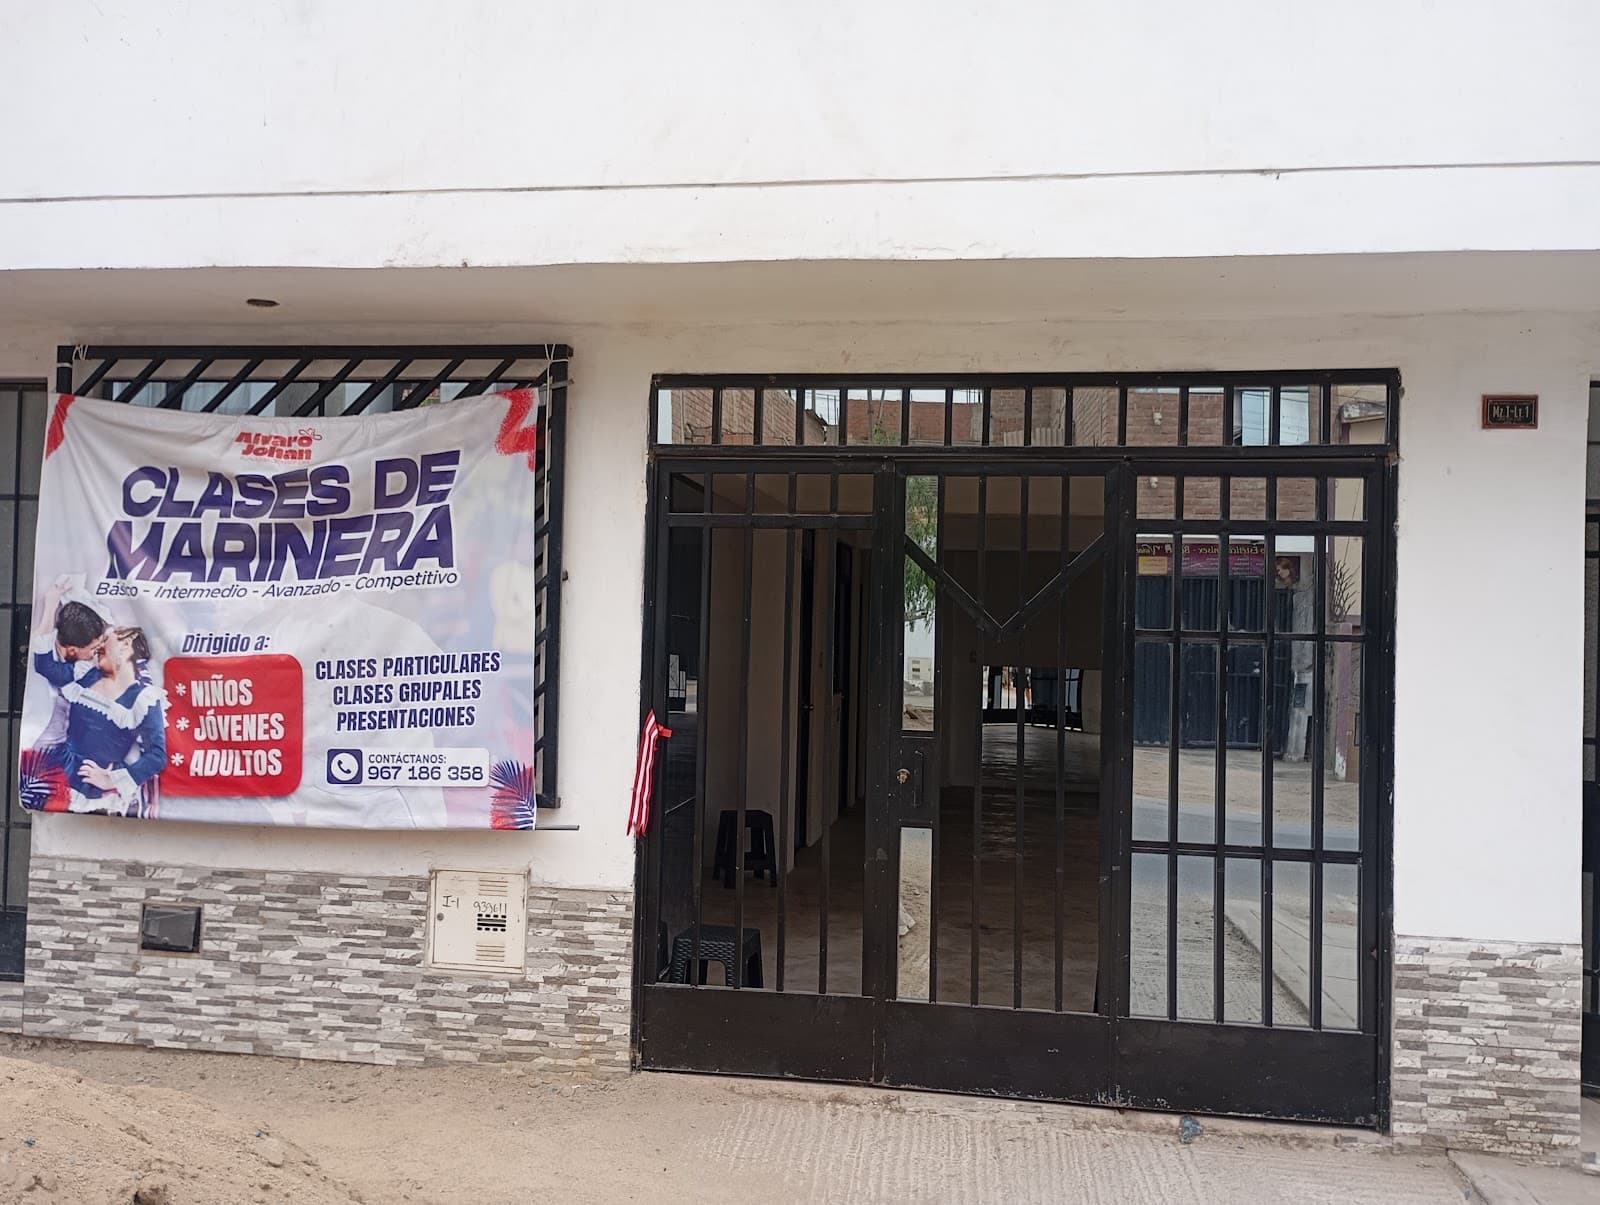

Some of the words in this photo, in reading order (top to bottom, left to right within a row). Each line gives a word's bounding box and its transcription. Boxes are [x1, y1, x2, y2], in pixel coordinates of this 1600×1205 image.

[235, 432, 313, 447] Alvaro
[242, 444, 312, 460] Johan
[122, 465, 350, 519] CLASES
[375, 450, 460, 509] DE
[106, 504, 455, 582] MARINERA
[154, 584, 248, 599] Intermedio
[261, 579, 341, 598] Avanzado
[355, 571, 458, 591] Competitivo
[182, 633, 251, 655] Dirigido
[254, 635, 271, 651] a:
[315, 658, 377, 680] CLASES
[382, 652, 501, 677] PARTICULARES
[190, 674, 253, 707] NIÑOS
[332, 684, 394, 706] CLASES
[399, 679, 482, 703] GRUPALES
[193, 709, 285, 742] JÓVENES
[336, 705, 476, 732] PRESENTACIONES
[189, 748, 283, 777] ADULTOS
[368, 752, 447, 764] CONTÁCTANOS:
[368, 766, 402, 780] 967
[408, 766, 441, 780] 186
[447, 766, 484, 780] 358
